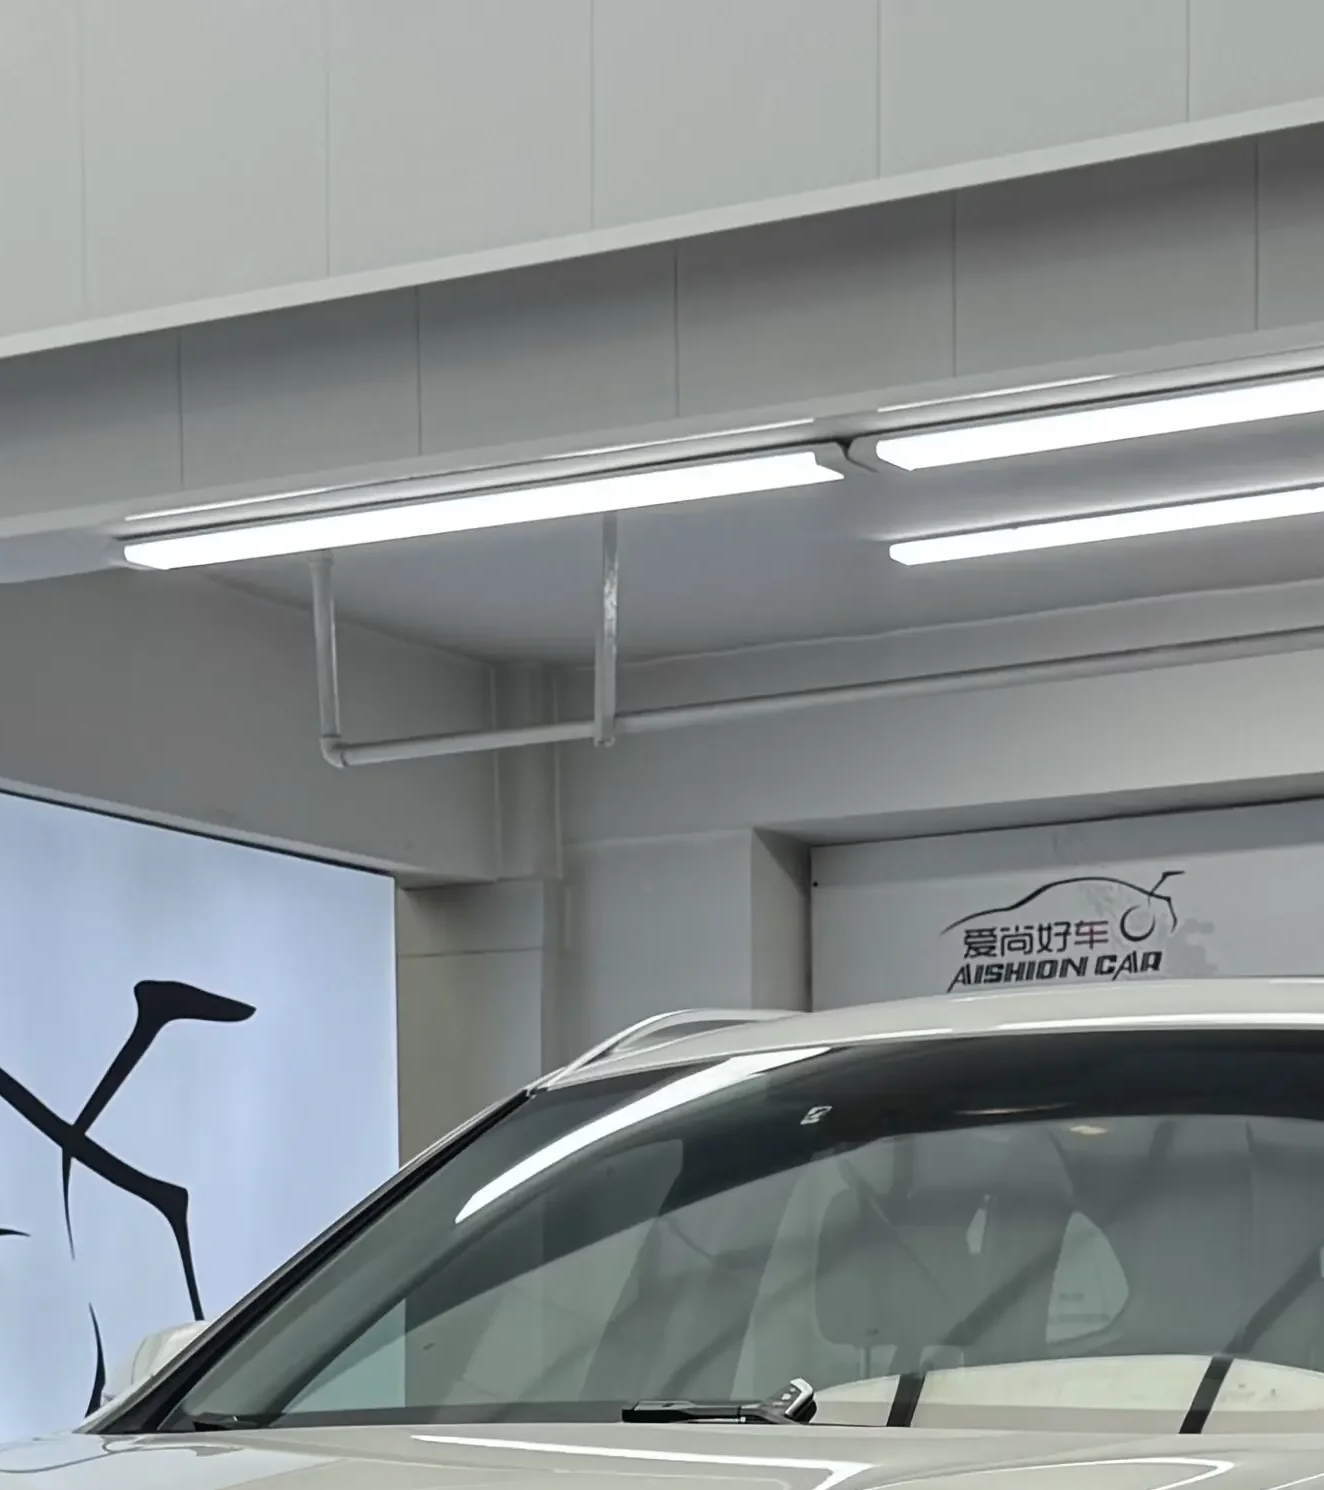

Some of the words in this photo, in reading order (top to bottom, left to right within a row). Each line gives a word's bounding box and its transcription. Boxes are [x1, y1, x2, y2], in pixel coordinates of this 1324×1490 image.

[963, 920, 1109, 959] 爱尚好车
[946, 955, 1089, 993] AISHION
[1094, 950, 1163, 981] CAR
